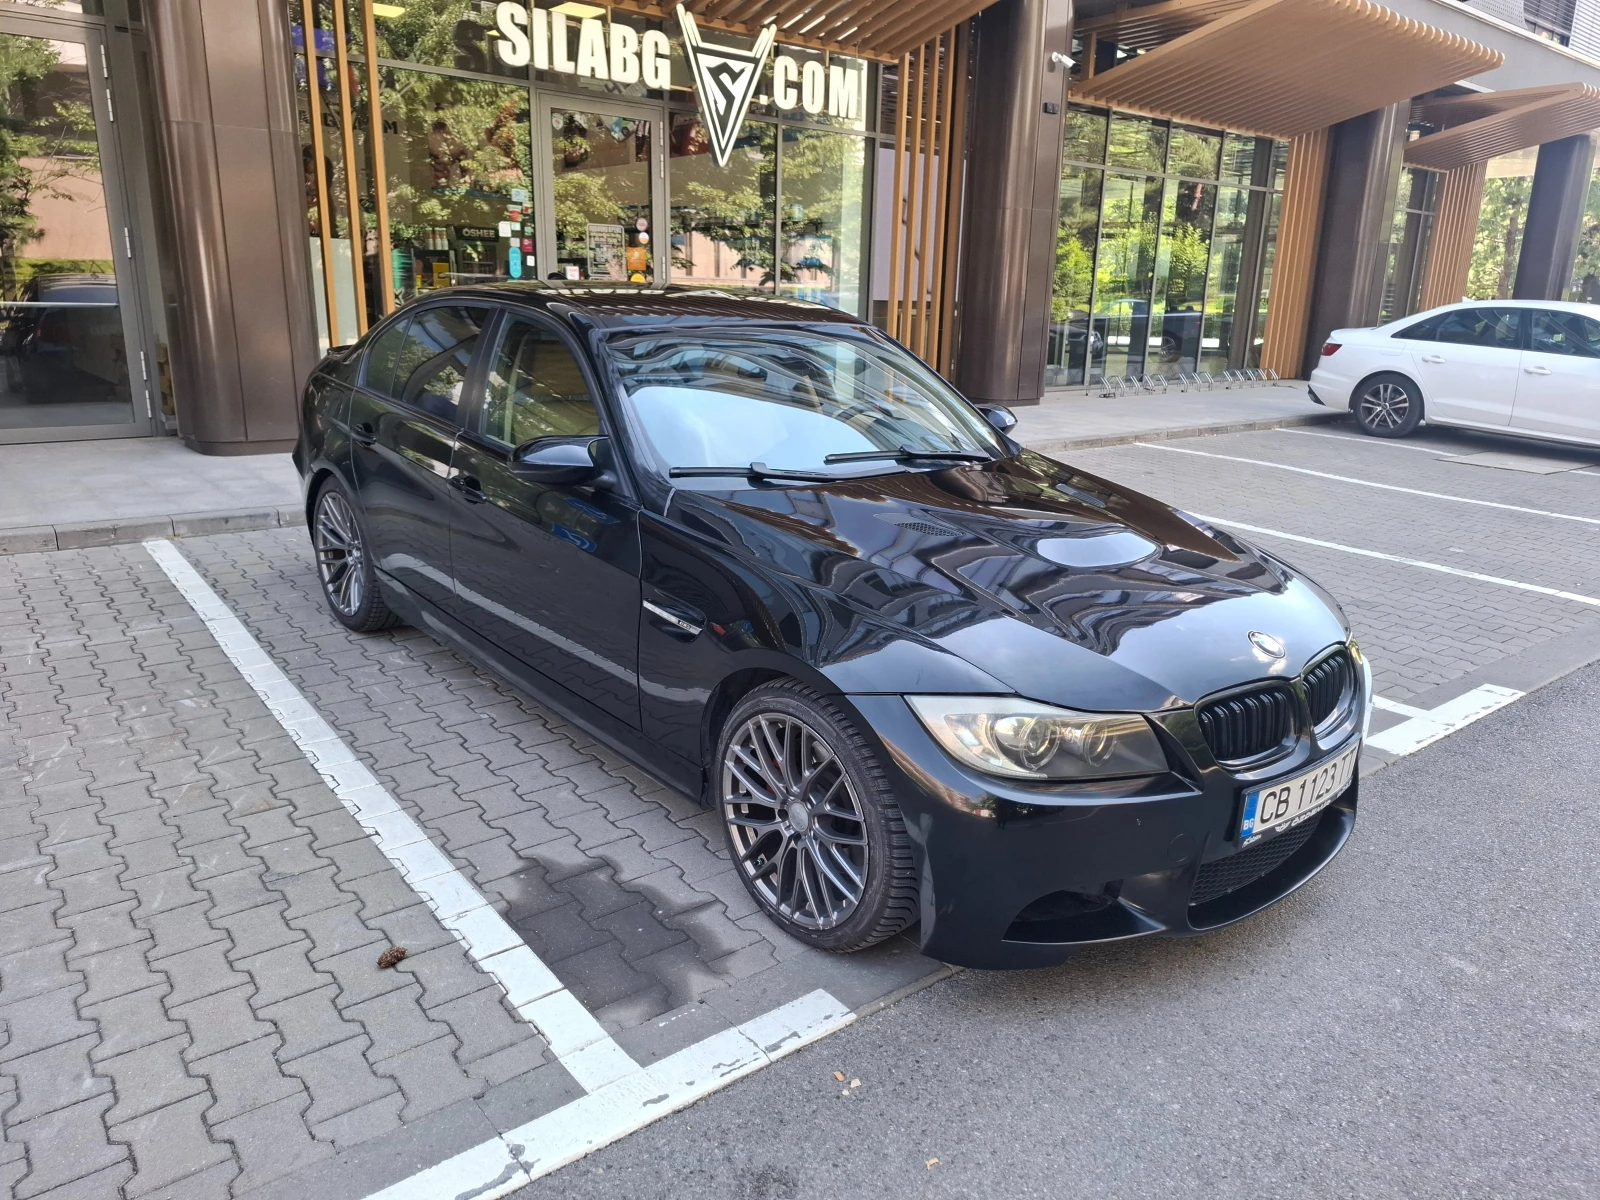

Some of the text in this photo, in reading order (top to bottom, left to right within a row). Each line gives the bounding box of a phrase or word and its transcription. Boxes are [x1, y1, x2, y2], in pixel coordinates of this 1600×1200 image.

[496, 1, 671, 90] SILABG
[462, 228, 496, 238] OSHEE
[1260, 786, 1291, 824] CB
[1298, 762, 1337, 810] 1123
[1243, 818, 1255, 831] BG
